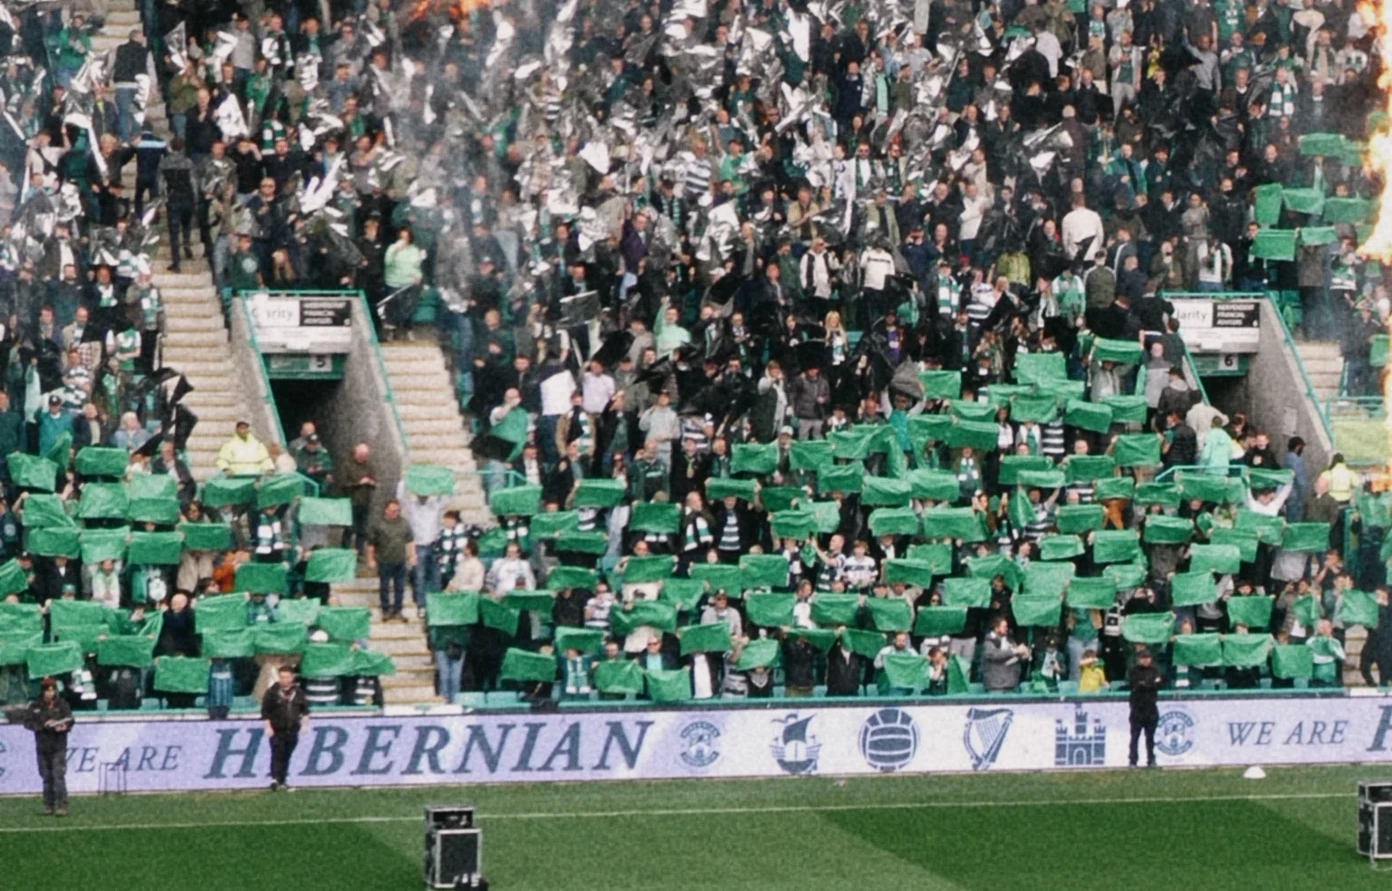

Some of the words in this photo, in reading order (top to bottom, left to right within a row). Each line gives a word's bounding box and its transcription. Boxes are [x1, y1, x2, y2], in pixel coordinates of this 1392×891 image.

[1176, 308, 1208, 320] larity
[1223, 354, 1234, 367] 6
[1227, 721, 1273, 747] WE
[1282, 719, 1349, 746] ARE
[109, 745, 183, 773] ARE
[202, 719, 655, 779] HBERNIAN
